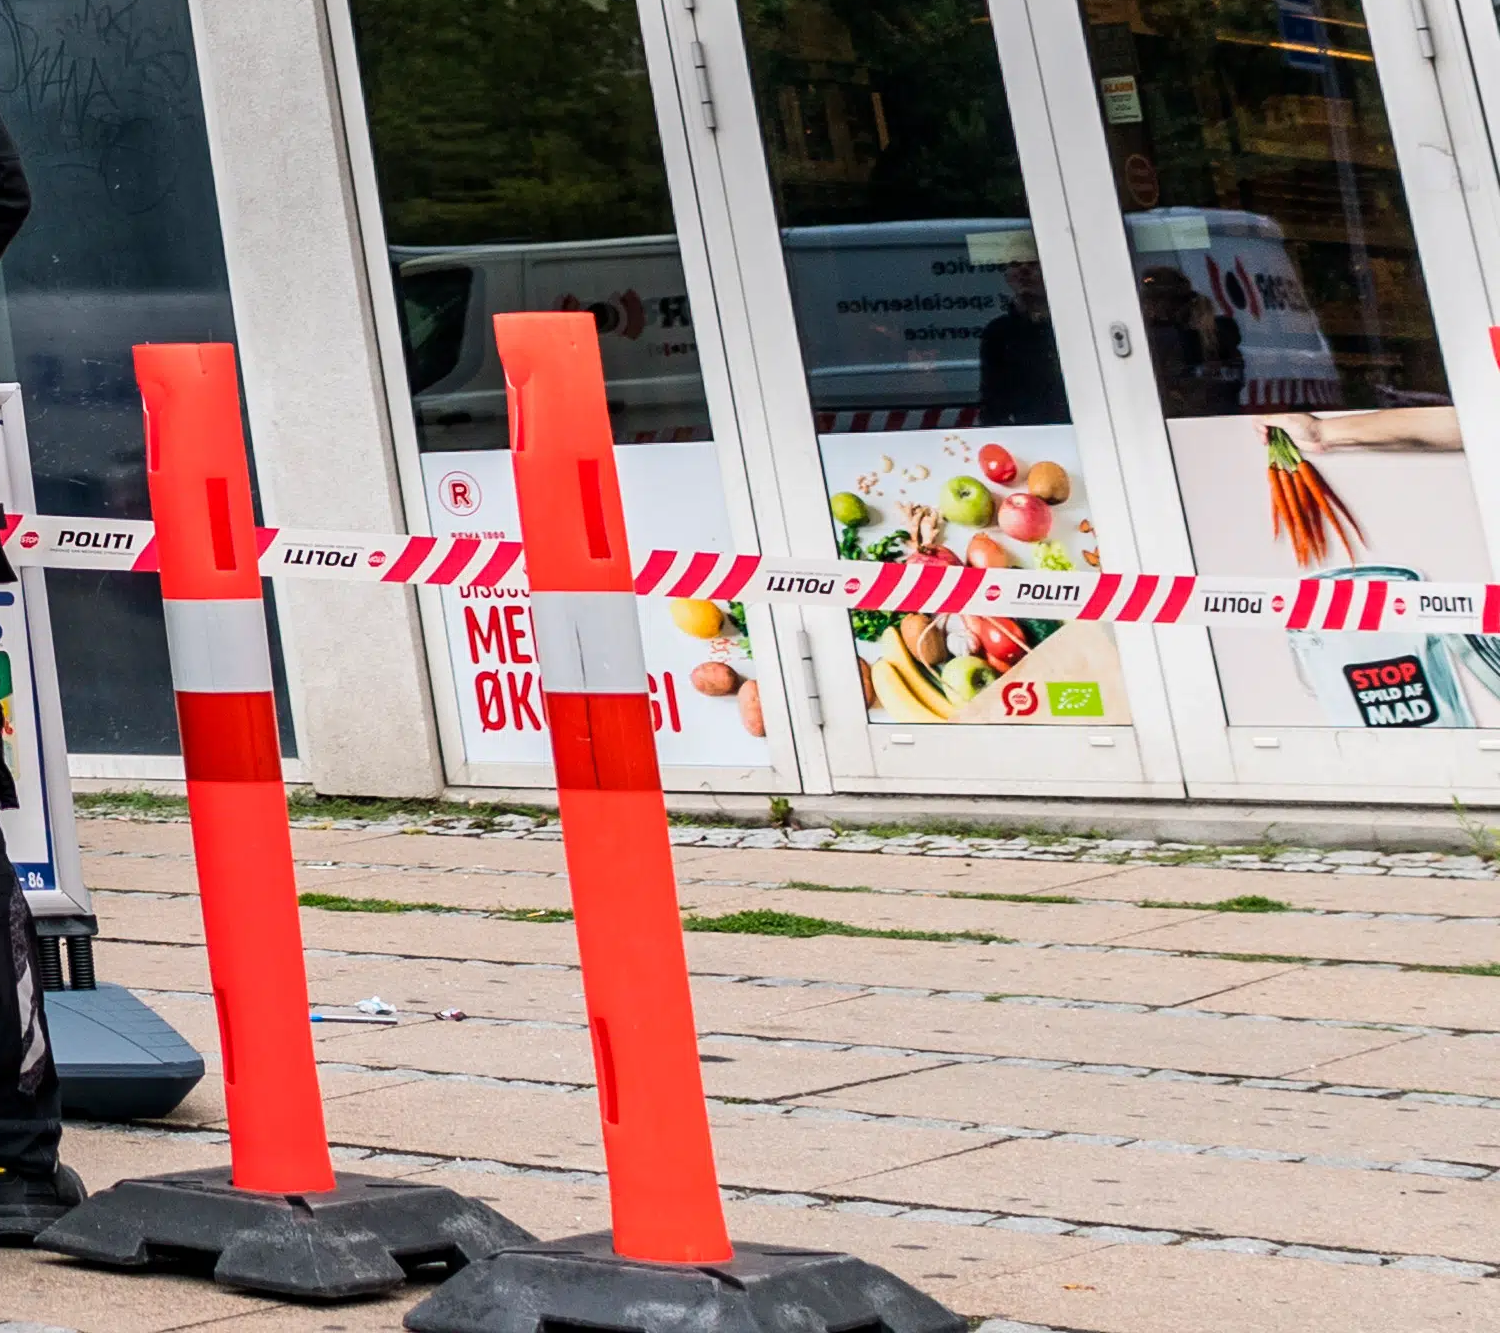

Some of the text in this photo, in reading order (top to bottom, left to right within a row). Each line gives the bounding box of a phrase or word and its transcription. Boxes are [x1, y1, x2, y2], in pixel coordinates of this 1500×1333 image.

[449, 480, 473, 509] R
[19, 530, 135, 550] STOP POLITI
[283, 549, 357, 568] POLITI
[767, 576, 835, 595] POLITI
[1017, 583, 1080, 602] POLITI
[1204, 596, 1263, 614] POLITI
[1420, 595, 1474, 613] POLITI
[464, 605, 539, 665] ME
[1351, 661, 1417, 690] STOP
[1358, 683, 1425, 704] SPILD AF
[1366, 698, 1432, 726] MAD
[28, 871, 45, 889] 86
